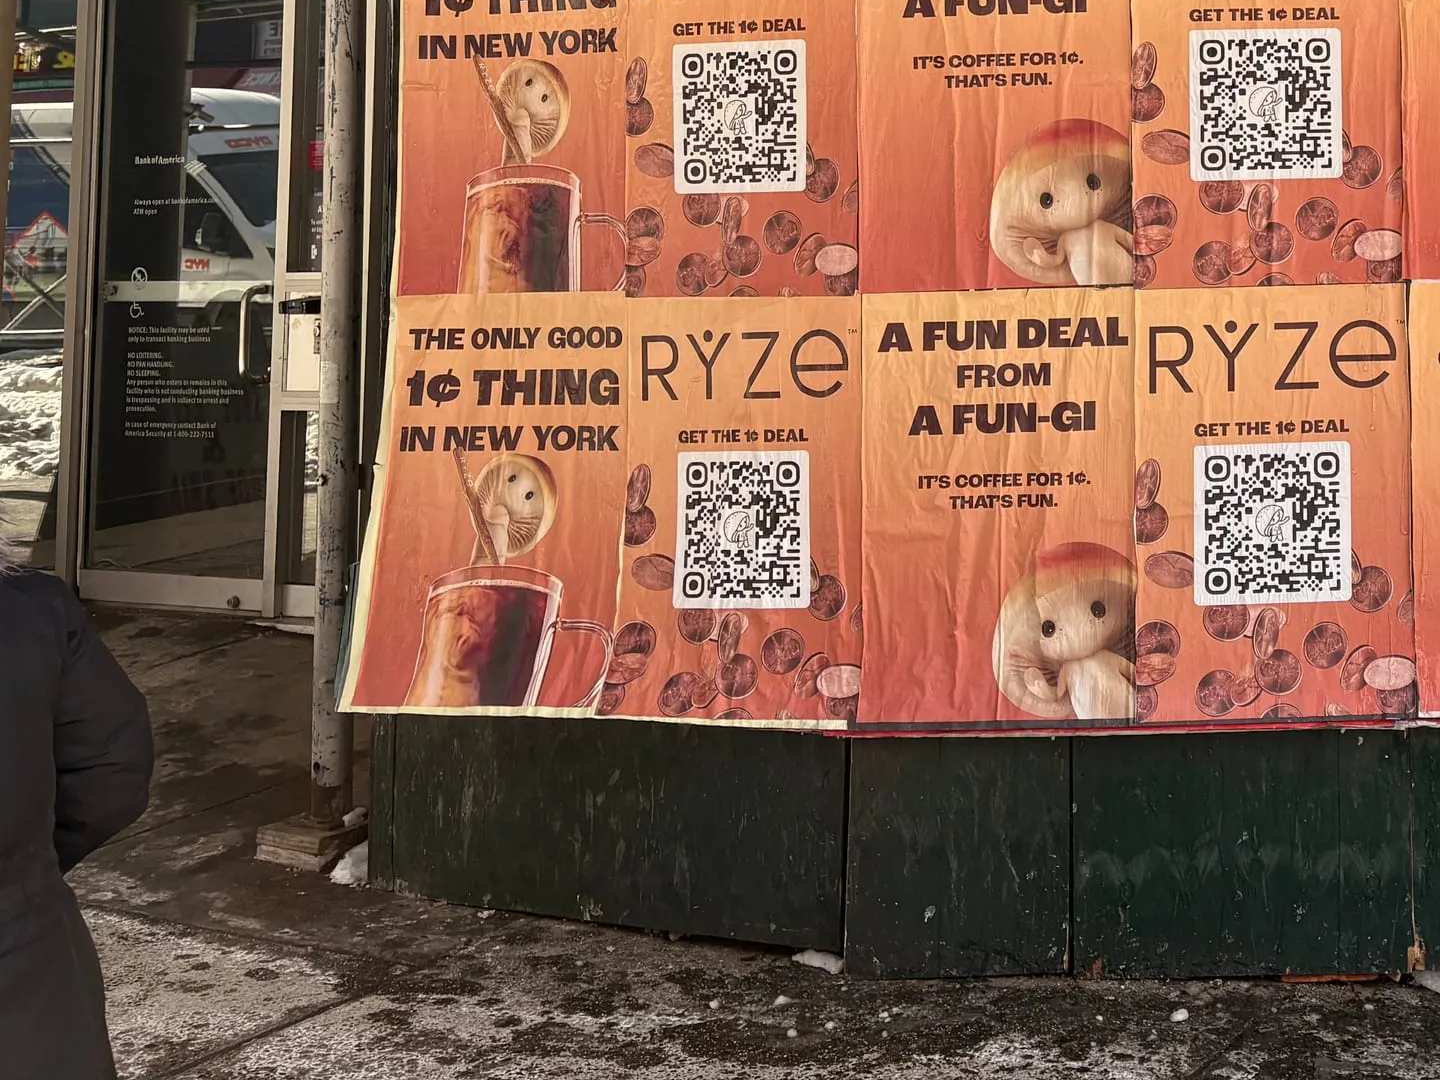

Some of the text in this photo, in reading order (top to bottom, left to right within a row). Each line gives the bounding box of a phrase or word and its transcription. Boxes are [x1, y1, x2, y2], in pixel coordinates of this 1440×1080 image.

[1189, 6, 1340, 23] GET THE 1¢ DEAL
[672, 18, 806, 37] GET THE 1¢ DEAL
[418, 27, 618, 60] IN NEW YORK
[947, 52, 1017, 69] COFFEE
[1019, 52, 1056, 68] FOR
[1010, 70, 1053, 87] FUN.
[135, 155, 151, 165] Bank
[158, 154, 185, 165] America
[409, 325, 623, 351] THE ONLY GOOD
[877, 316, 1129, 353] A FUN DEAL
[956, 362, 1052, 388] FROM
[405, 367, 621, 409] 1¢ THING
[908, 400, 1096, 436] A FUN-GI
[399, 424, 620, 452] IN NEW YORK
[677, 429, 708, 445] GET
[710, 429, 741, 444] THE
[762, 428, 809, 443] DEAL
[1194, 419, 1350, 438] GET THE 1¢ DEAL
[954, 472, 1023, 488] COFFEE
[1025, 472, 1063, 488] FOR
[1016, 491, 1058, 508] FUN.
